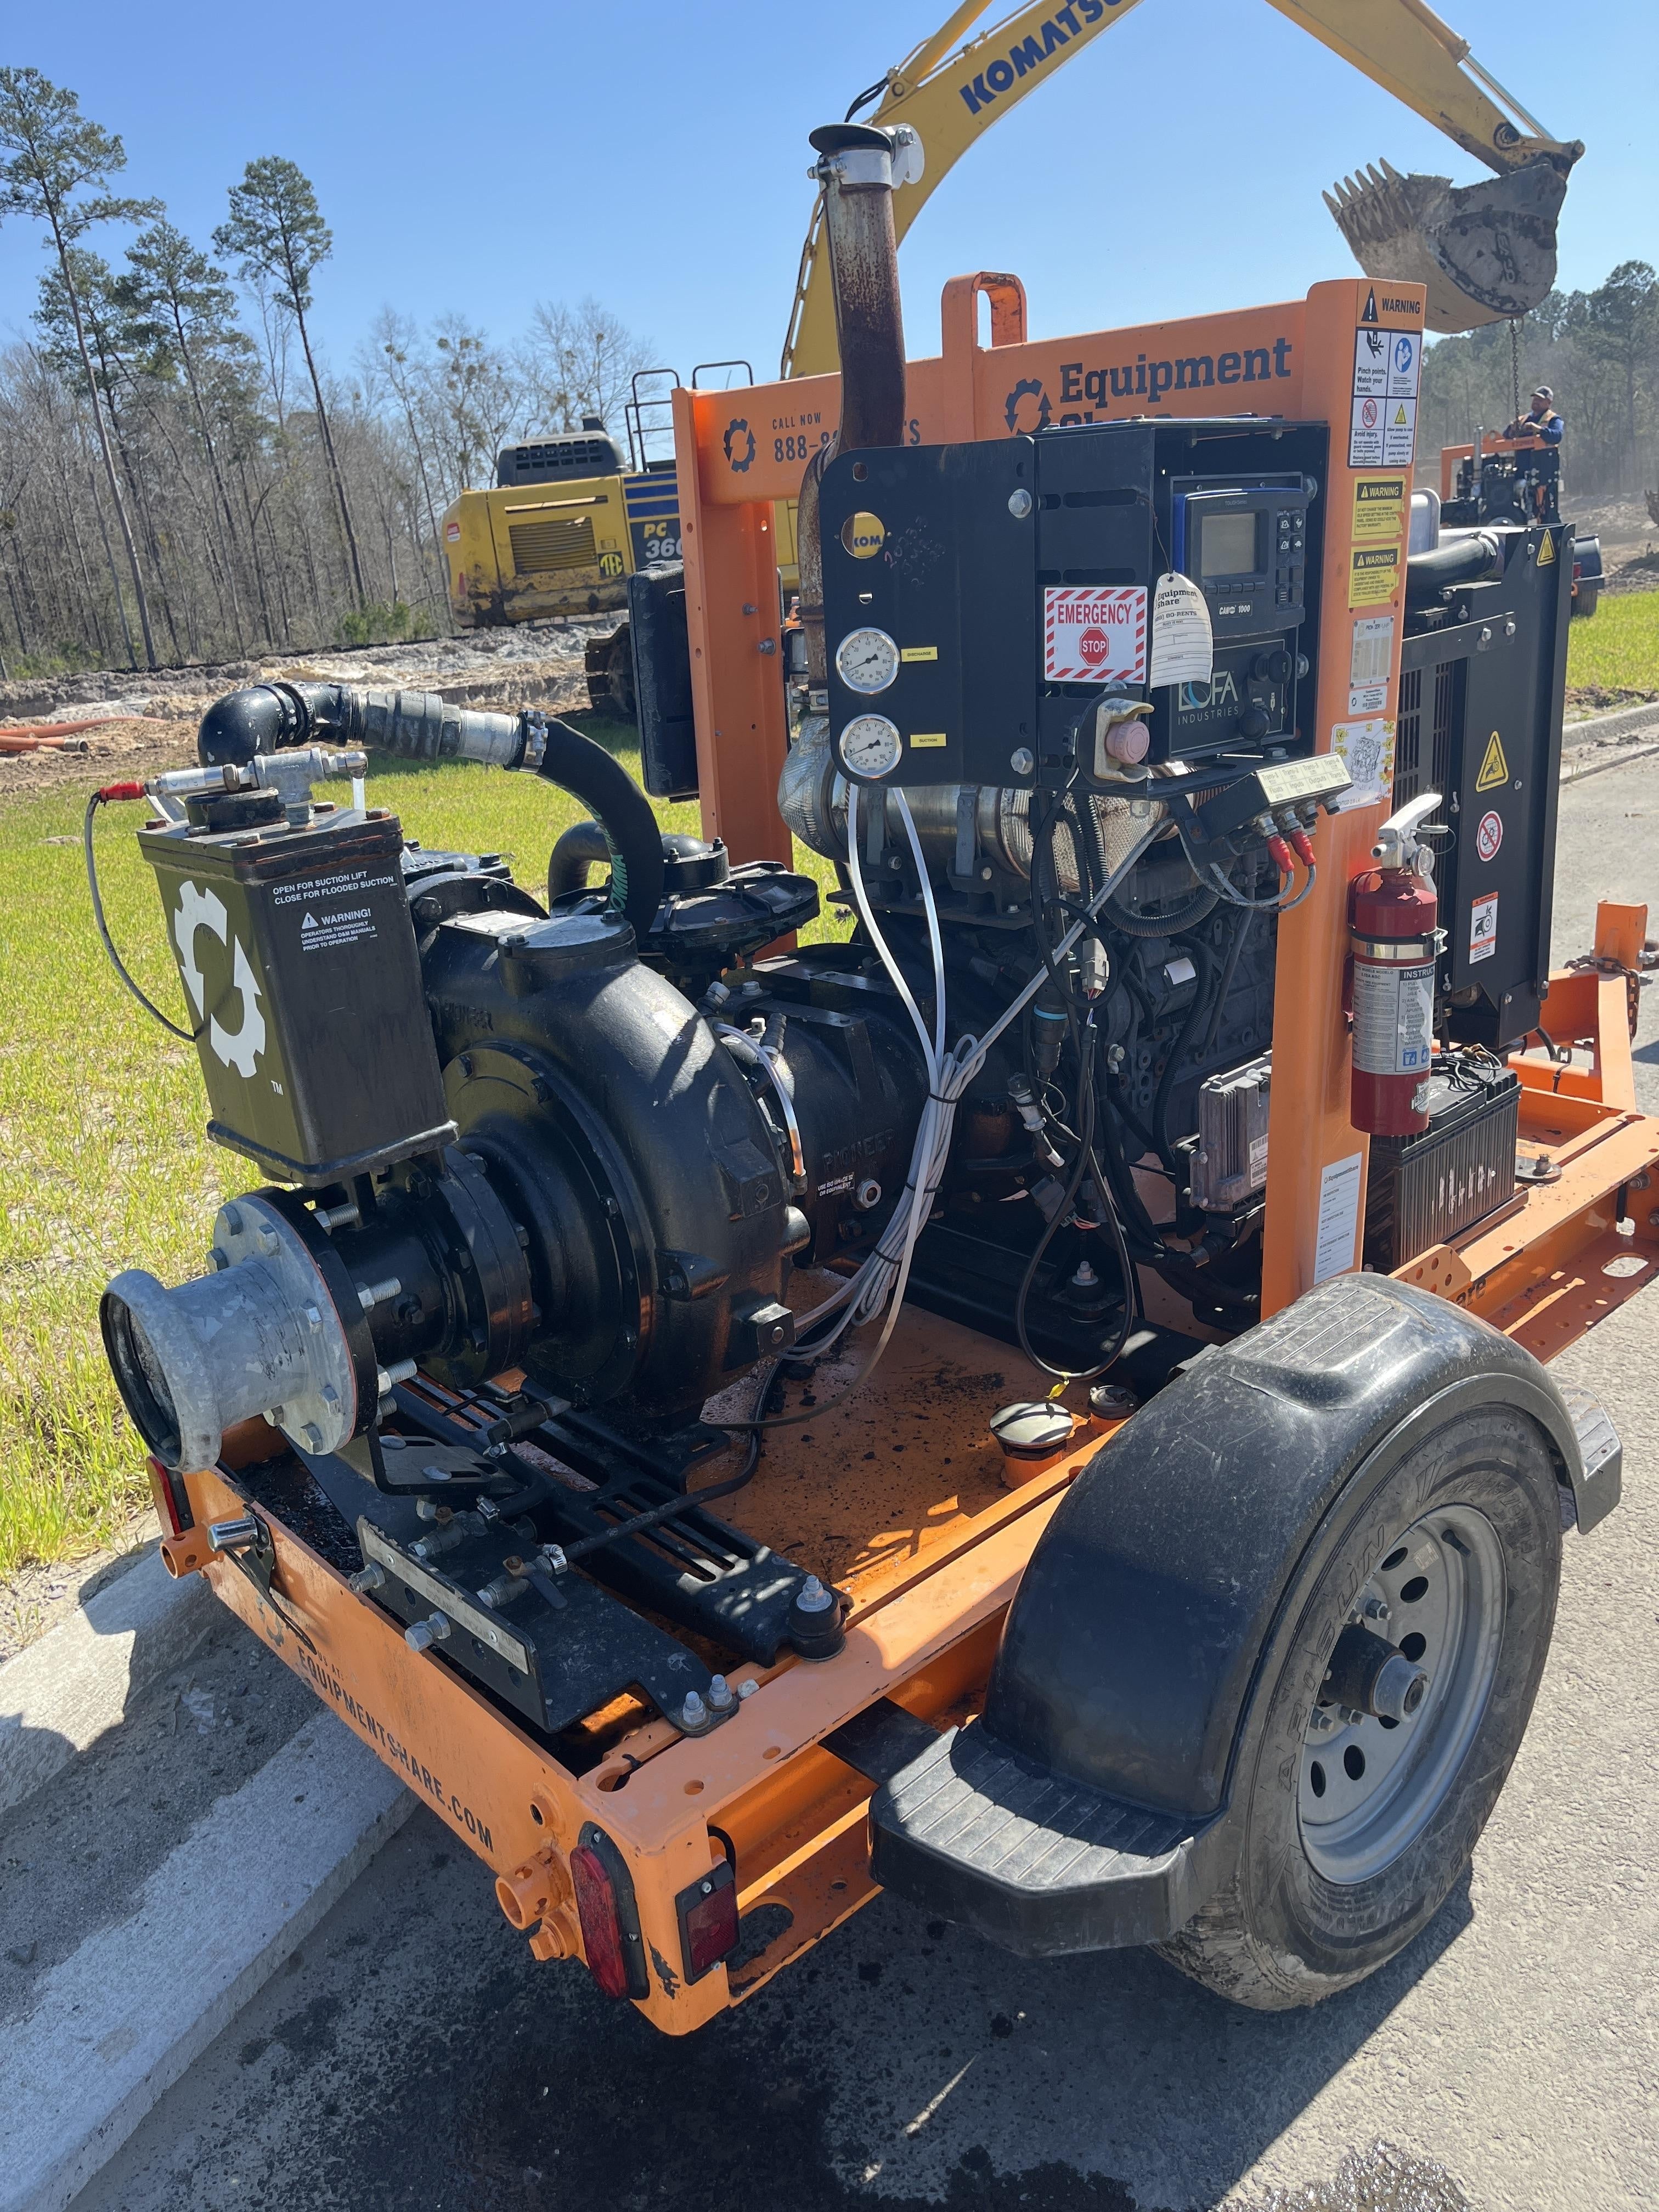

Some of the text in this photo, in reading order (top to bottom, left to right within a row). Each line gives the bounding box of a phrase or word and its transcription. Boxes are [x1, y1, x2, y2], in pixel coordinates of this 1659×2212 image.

[958, 0, 1126, 115] KOMATS
[1382, 298, 1420, 314] WARNING
[1059, 337, 1293, 409] Equipment
[772, 413, 821, 430] CALL NOW
[1369, 487, 1399, 497] WARNING
[644, 522, 668, 539] PC
[600, 554, 623, 577] TEC
[1365, 554, 1393, 565] WARNING
[1157, 598, 1180, 609] Share
[1158, 589, 1198, 601] Equipment
[1058, 603, 1133, 624] EMERGENCY
[1238, 605, 1251, 613] 1000
[1082, 636, 1107, 654] STOP
[1178, 706, 1239, 725] INDUSTRIES
[1261, 758, 1340, 781] Trans-1 Trans-2 Trans-3 Trans-4
[273, 871, 368, 895] OPEN FOR SUCTION LIFT
[274, 894, 302, 905] CLOSE
[303, 890, 320, 900] FOR
[321, 882, 359, 896] FLOODED
[360, 876, 394, 888] SUCTION
[321, 908, 371, 926] WARNING!
[301, 921, 369, 939] OPERATORS THOROUGHLY
[302, 933, 337, 945] UNDERSTAND
[350, 926, 376, 936] MANUALS
[303, 943, 320, 951] PRIOR
[329, 935, 358, 946] OPERATION
[270, 1080, 284, 1096] TM
[823, 1128, 895, 1173] PIONEER
[817, 1182, 827, 1190] USE
[826, 1181, 851, 1194] EQUIVALENT
[1278, 1524, 1385, 1792] ARISUN
[297, 1644, 494, 1854] EQUIPMENTSHARE.COM
